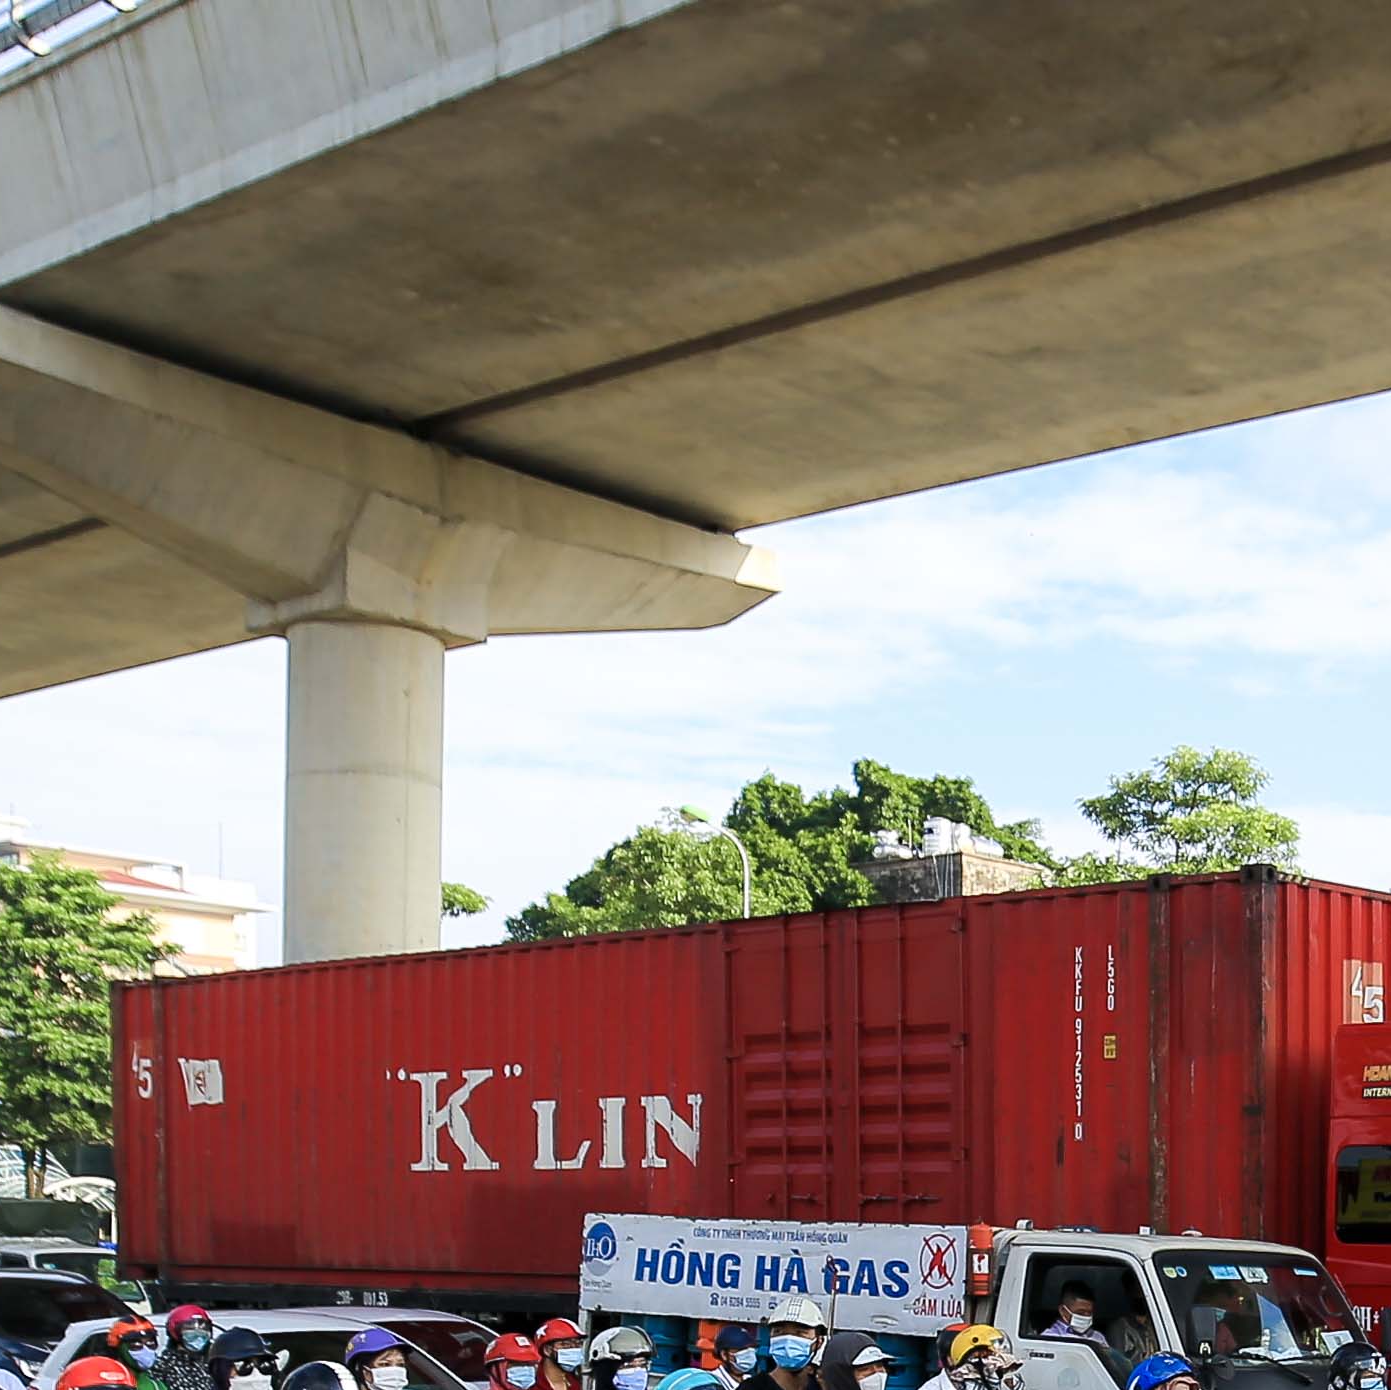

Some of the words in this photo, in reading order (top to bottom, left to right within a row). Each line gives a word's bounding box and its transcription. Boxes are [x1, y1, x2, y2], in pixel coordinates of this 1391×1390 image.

[1074, 946, 1083, 1012] KKFU
[1351, 966, 1384, 1023] 45
[1074, 1018, 1083, 1117] 912531
[634, 1237, 742, 1290] HỒNG
[754, 1248, 808, 1294] HÀ
[823, 1257, 909, 1299] GAS
